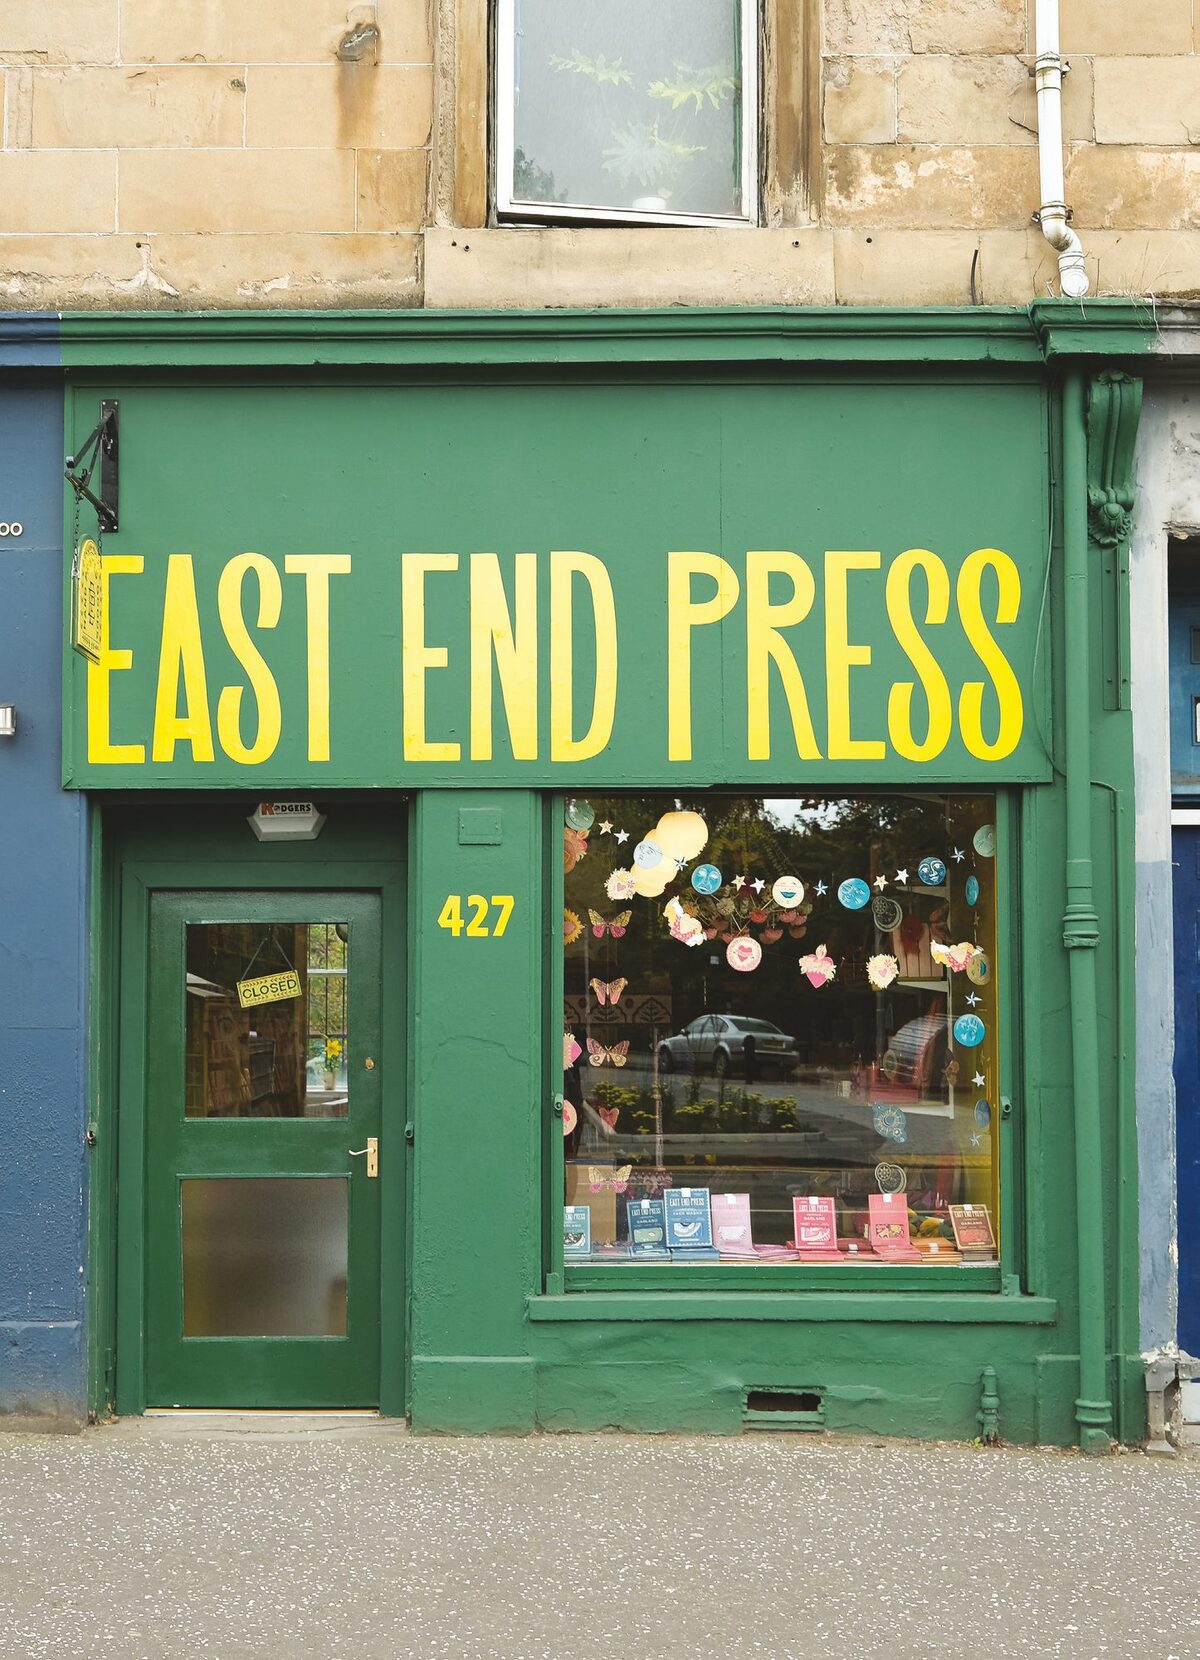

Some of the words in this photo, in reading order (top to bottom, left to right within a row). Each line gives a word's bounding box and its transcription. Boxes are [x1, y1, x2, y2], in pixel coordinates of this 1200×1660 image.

[87, 553, 352, 764] EAST
[403, 552, 617, 763] END
[667, 549, 1023, 762] PRESS
[438, 895, 514, 938] 427
[242, 979, 297, 999] CLOSED
[690, 1197, 705, 1206] PRESS
